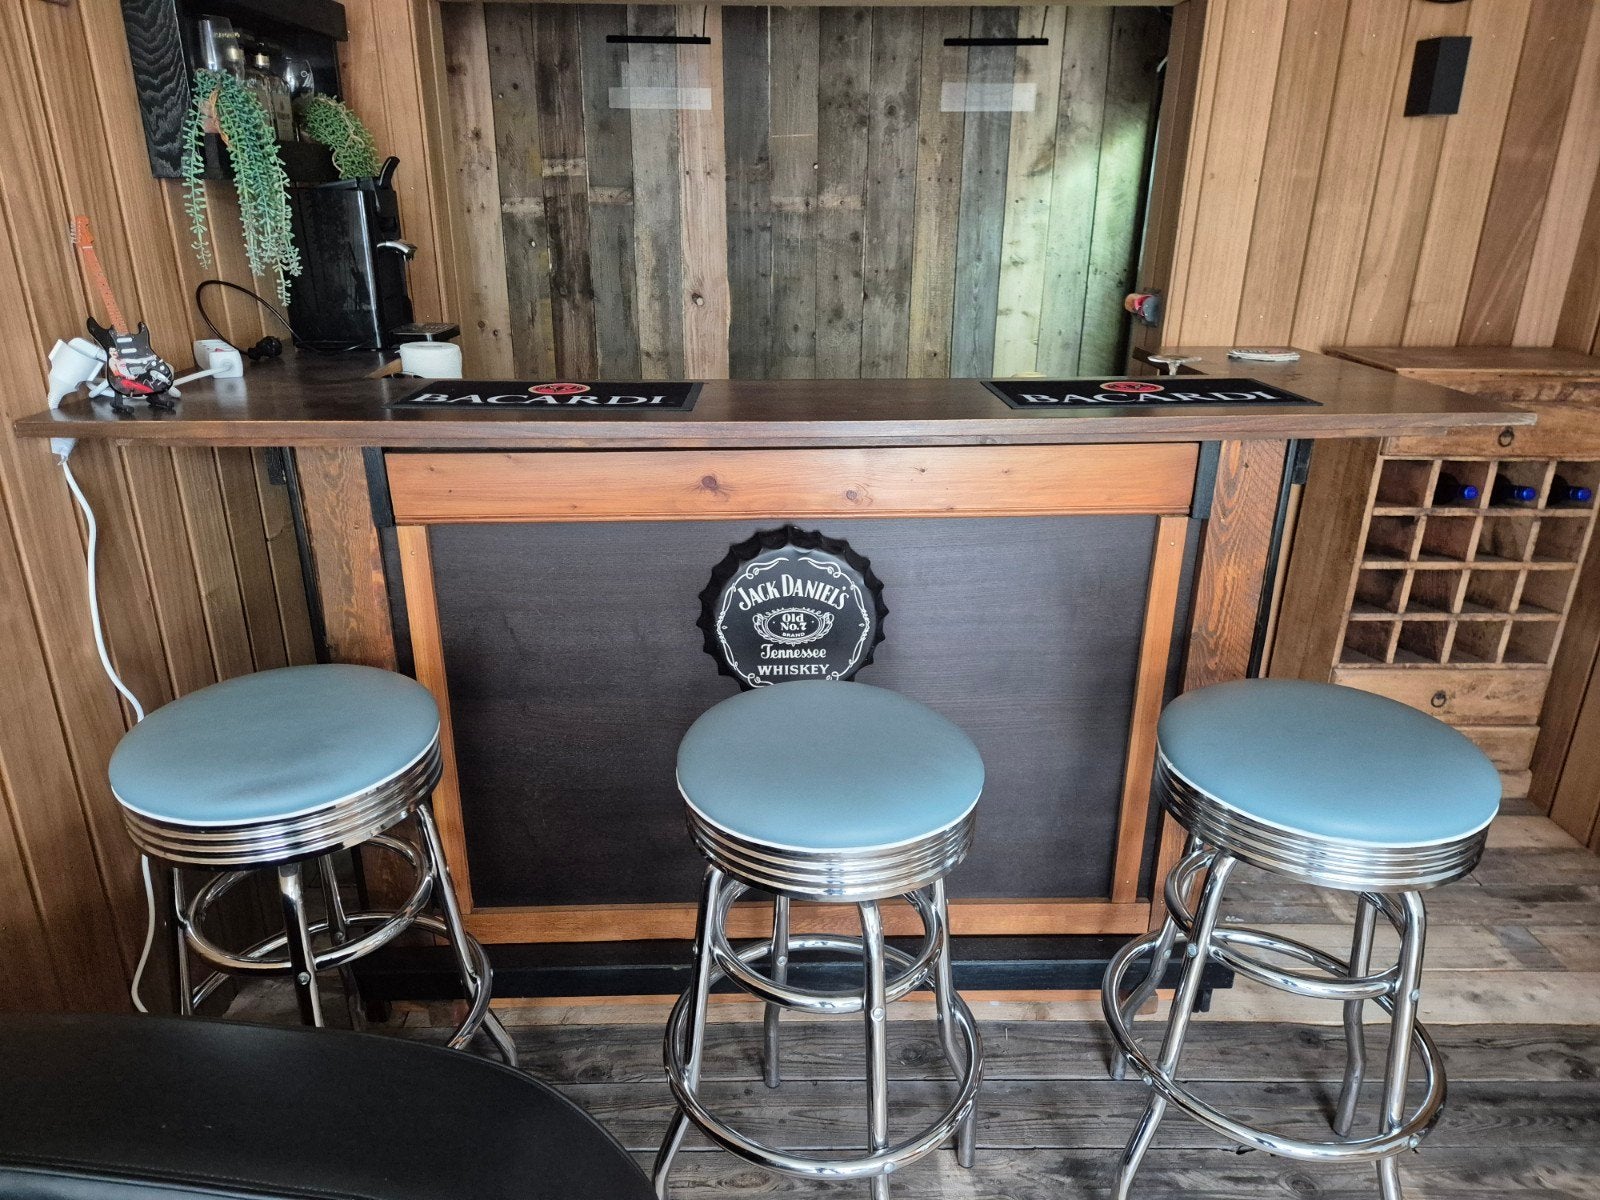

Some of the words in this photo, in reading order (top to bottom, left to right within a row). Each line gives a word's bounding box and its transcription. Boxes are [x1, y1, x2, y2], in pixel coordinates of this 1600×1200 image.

[412, 393, 668, 405] BACARDI
[1020, 391, 1279, 404] BACARDI
[737, 580, 780, 610] JACK
[781, 574, 849, 610] DANIEL'S
[782, 613, 804, 622] Old
[760, 643, 827, 659] Tennessee
[757, 664, 830, 676] WHISKEY
